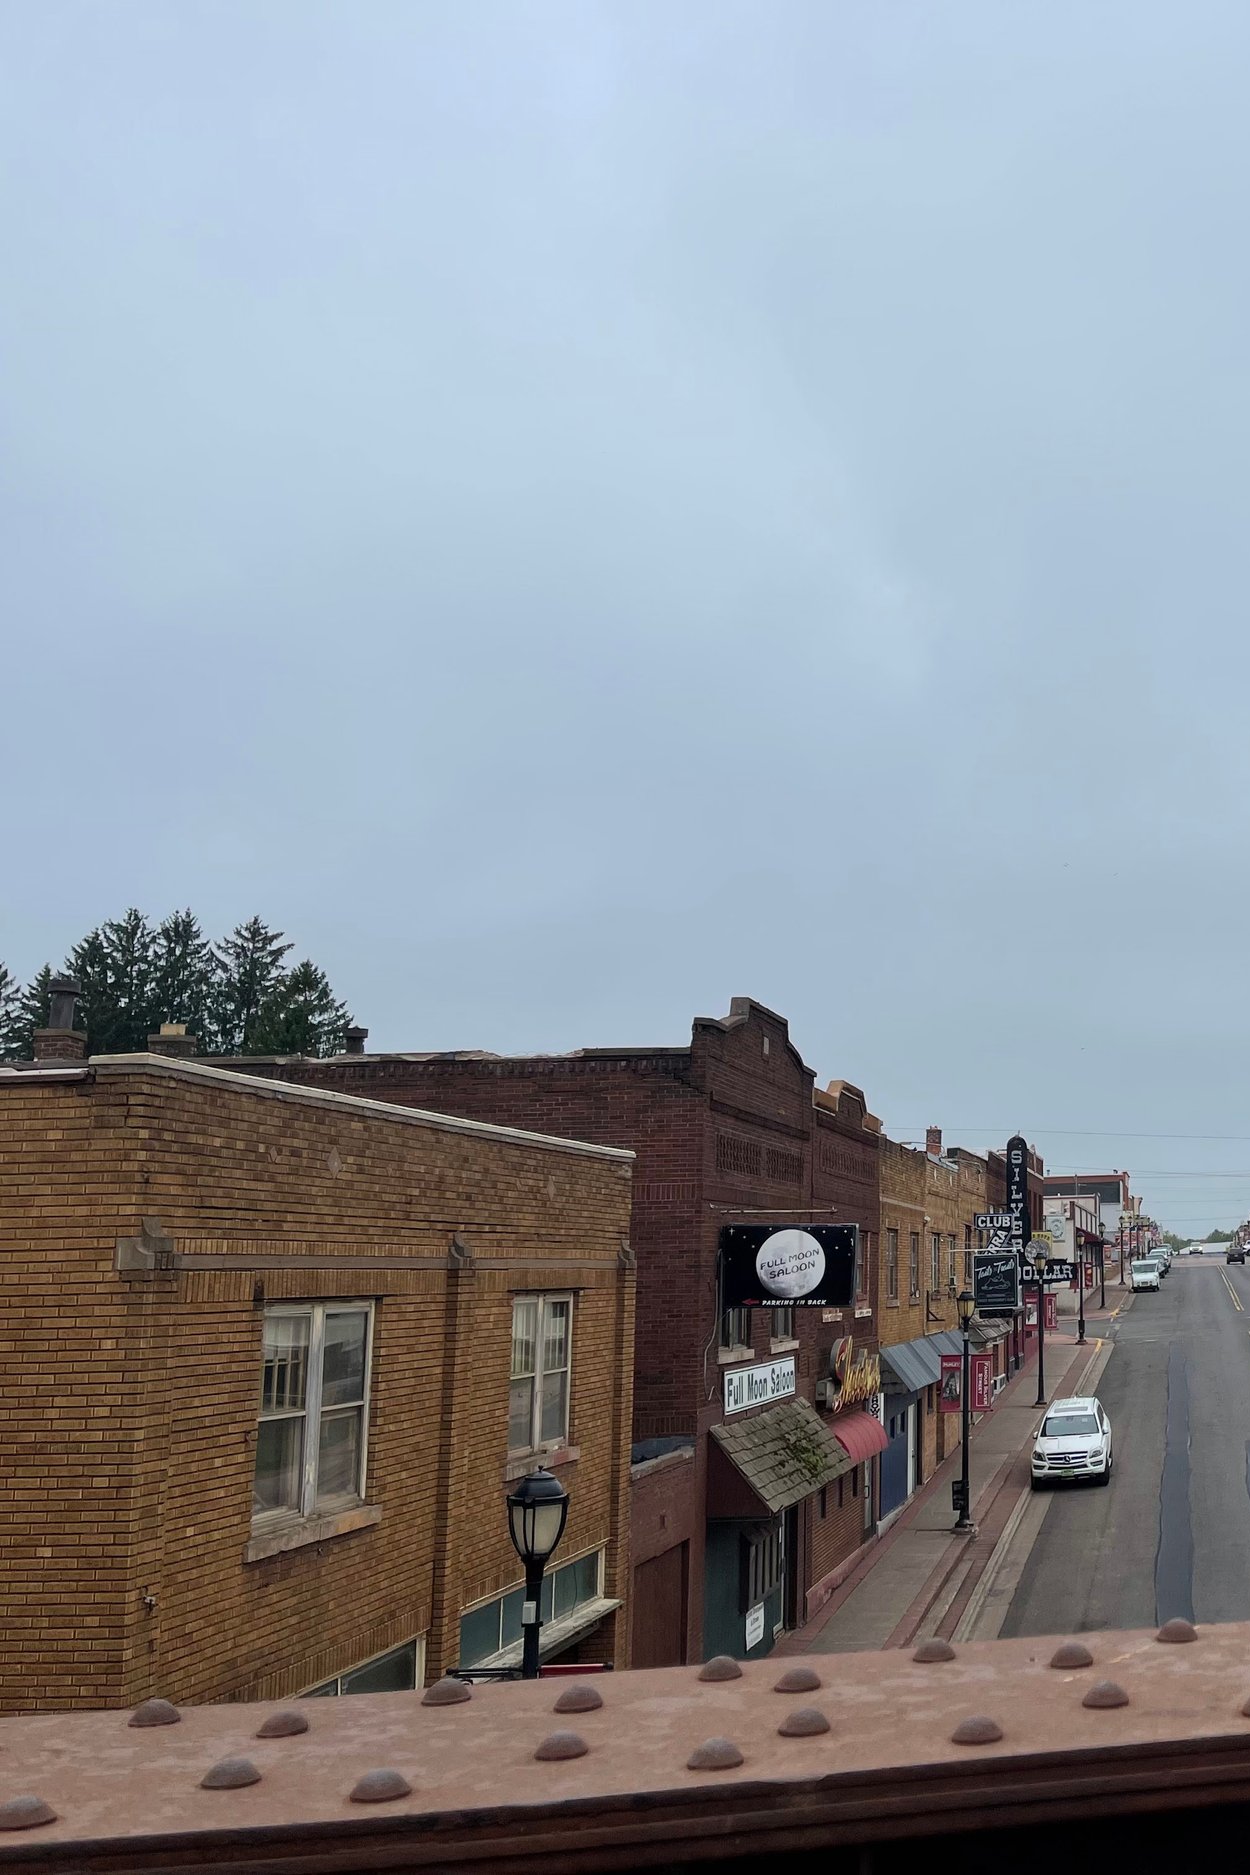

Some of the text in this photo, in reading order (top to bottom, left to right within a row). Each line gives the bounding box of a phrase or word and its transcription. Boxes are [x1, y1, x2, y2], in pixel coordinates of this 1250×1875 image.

[1011, 1150, 1023, 1252] SILVER
[978, 1216, 1011, 1228] CLUB
[760, 1248, 820, 1271] FULL MOON
[769, 1260, 816, 1280] SALOON
[727, 1367, 795, 1408] Full Moon Saloon
